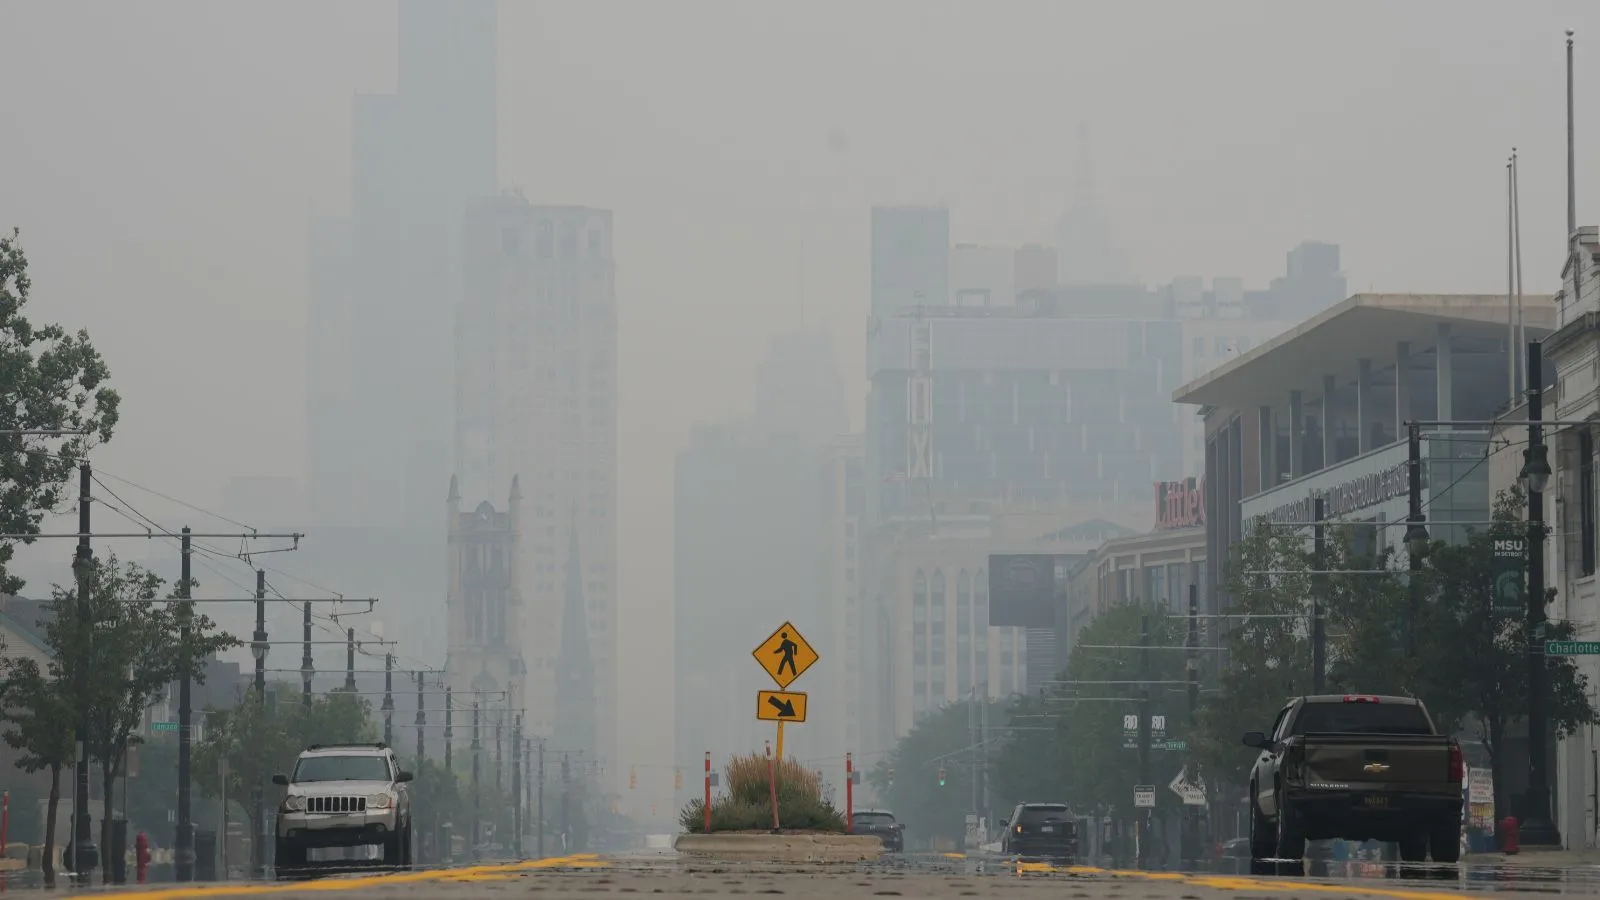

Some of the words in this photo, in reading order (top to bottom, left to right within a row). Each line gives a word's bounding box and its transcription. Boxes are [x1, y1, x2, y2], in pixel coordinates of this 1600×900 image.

[1153, 477, 1198, 527] Little
[1494, 540, 1523, 551] MSU
[1549, 642, 1600, 654] Charlotte
